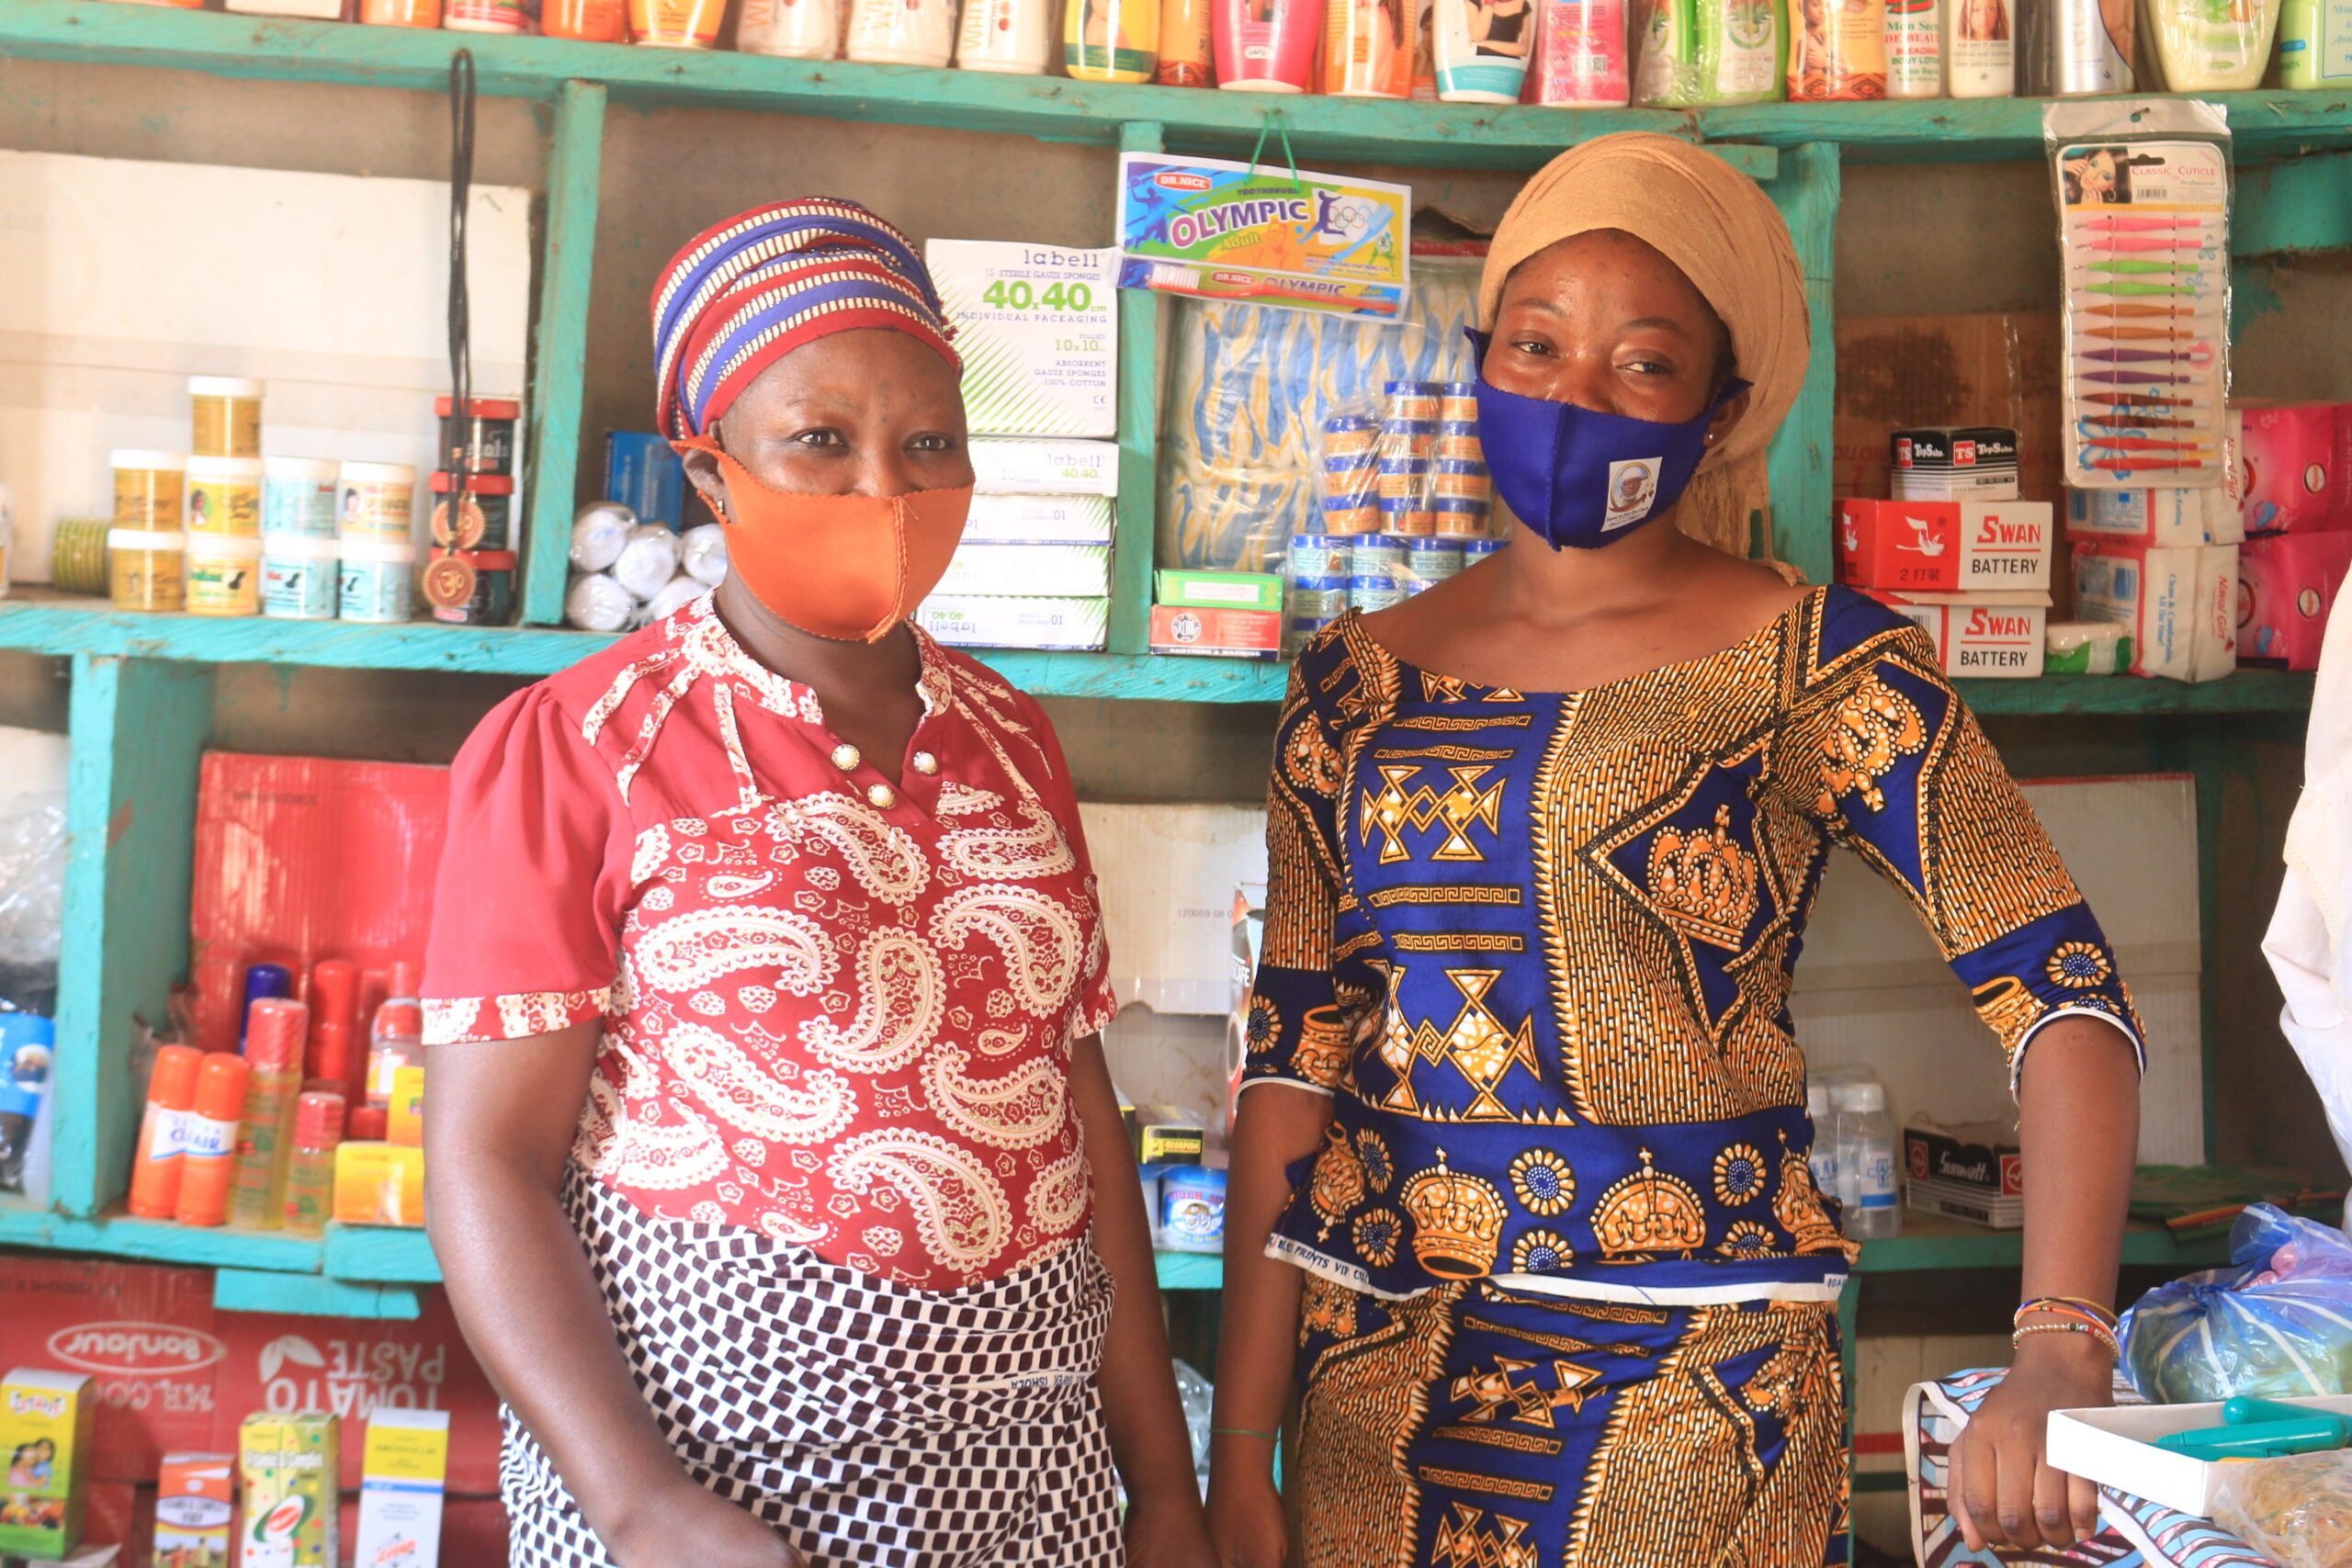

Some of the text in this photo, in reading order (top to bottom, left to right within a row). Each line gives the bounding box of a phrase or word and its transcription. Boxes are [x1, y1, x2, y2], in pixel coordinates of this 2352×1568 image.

[2132, 166, 2216, 176] CLASSIC CUTICLE
[1159, 175, 1207, 189] DR.NICE
[1170, 199, 1310, 249] OLYMPIC
[1221, 231, 1261, 251] Adult
[1024, 249, 1099, 267] labell
[1063, 272, 1102, 281] SPONGES
[1216, 273, 1255, 285] DR.NICE
[956, 312, 1107, 322] INDIVIDUAL PACKAGING
[1035, 368, 1106, 378] GAUZE SPONGES
[1047, 453, 1102, 468] labell
[1898, 446, 1912, 460] TS
[1955, 448, 1974, 459] TS
[1976, 515, 2041, 544] SWAN
[1972, 558, 2039, 574] BATTERY
[929, 621, 977, 634] labell
[1964, 608, 2031, 636] SWAN
[2217, 615, 2228, 640] Girl
[1222, 649, 1261, 657] WARMING
[1960, 651, 2029, 667] BATTERY
[1938, 1150, 1987, 1182] Sunwatt
[1295, 1246, 1329, 1269] PRINTS
[1335, 1262, 1350, 1276] VIP
[65, 1333, 201, 1362] Bonjour
[325, 1339, 446, 1384] PASTE
[1011, 1376, 1048, 1390] ISHOLA
